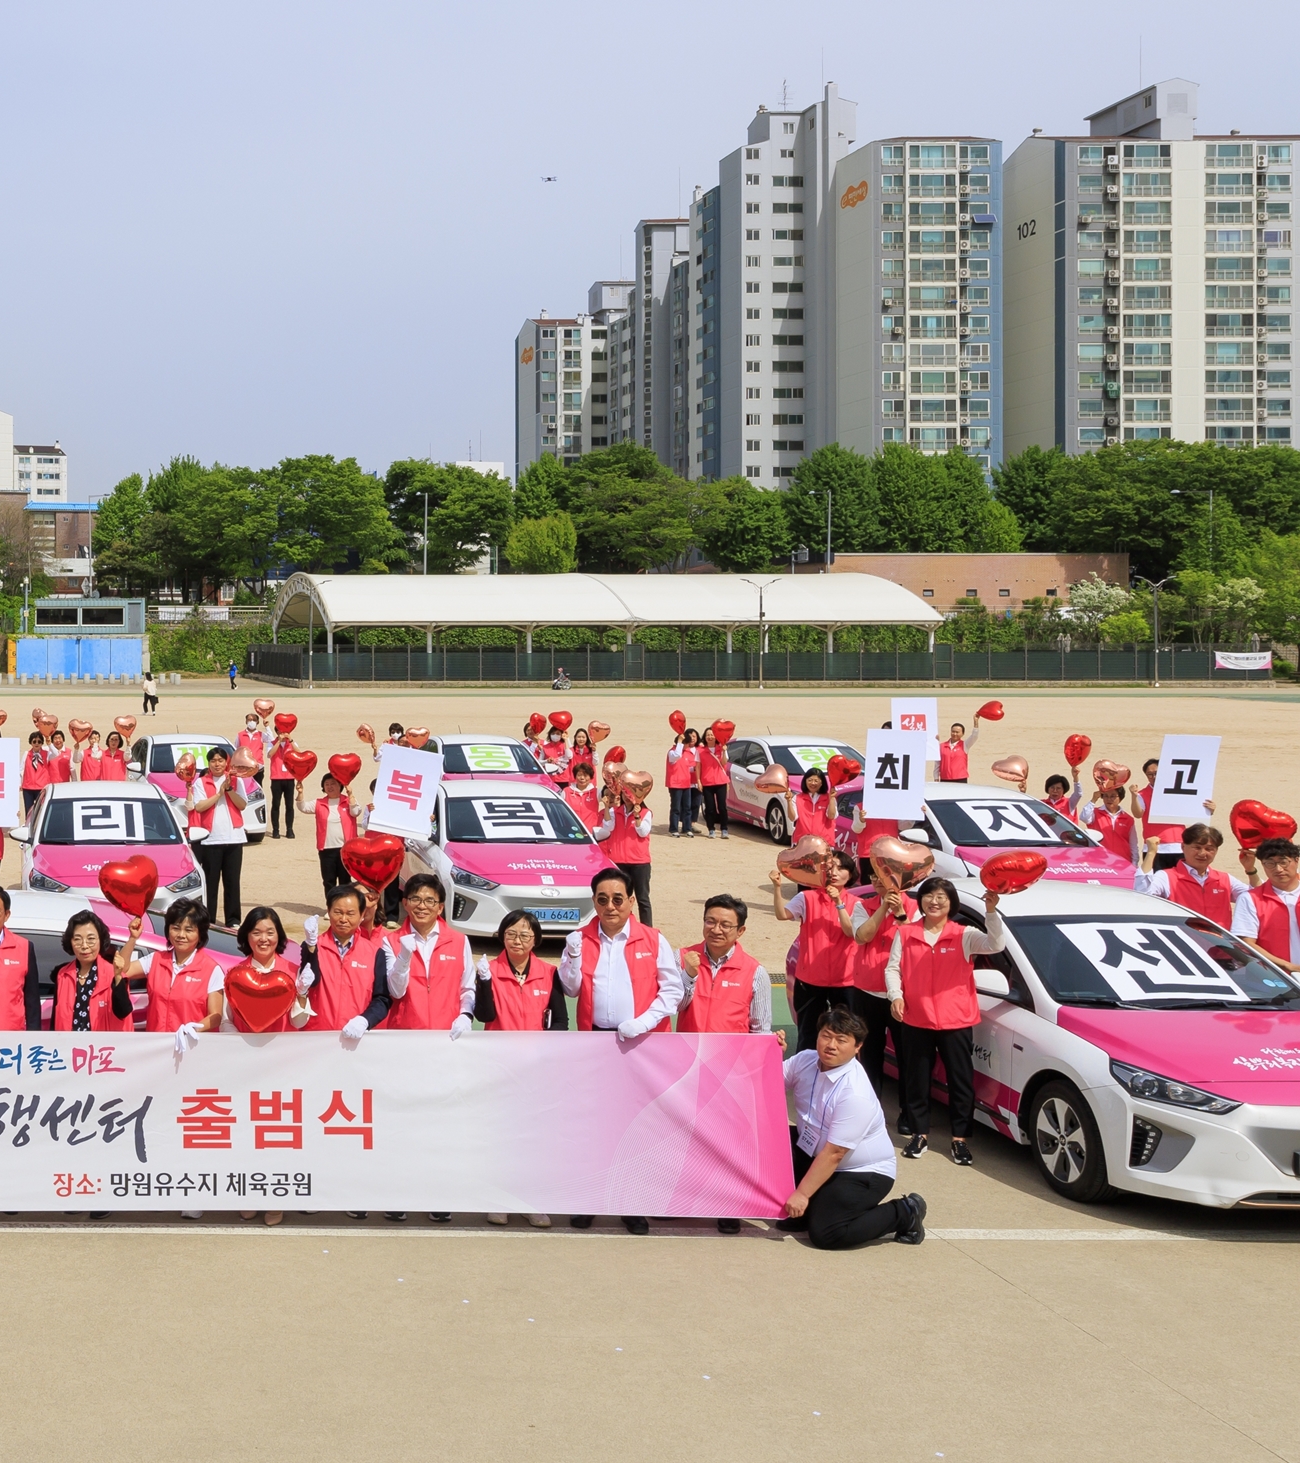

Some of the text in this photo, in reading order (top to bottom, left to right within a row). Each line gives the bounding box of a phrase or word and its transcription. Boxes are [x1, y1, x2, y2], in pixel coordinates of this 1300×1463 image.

[1017, 219, 1037, 241] 102
[468, 746, 512, 769] 동
[875, 753, 910, 790] 최
[387, 770, 423, 810] 복
[1164, 759, 1200, 795] 고
[81, 803, 136, 837] 리
[483, 802, 545, 836] 복
[973, 803, 1051, 839] 지
[550, 911, 575, 920] 6642
[1096, 928, 1238, 995] 센
[26, 1045, 66, 1073] 좋은
[72, 1045, 125, 1075] 마포
[177, 1089, 373, 1150] 출범식
[54, 1173, 312, 1197] 장소: 망원유수지 체육공원
